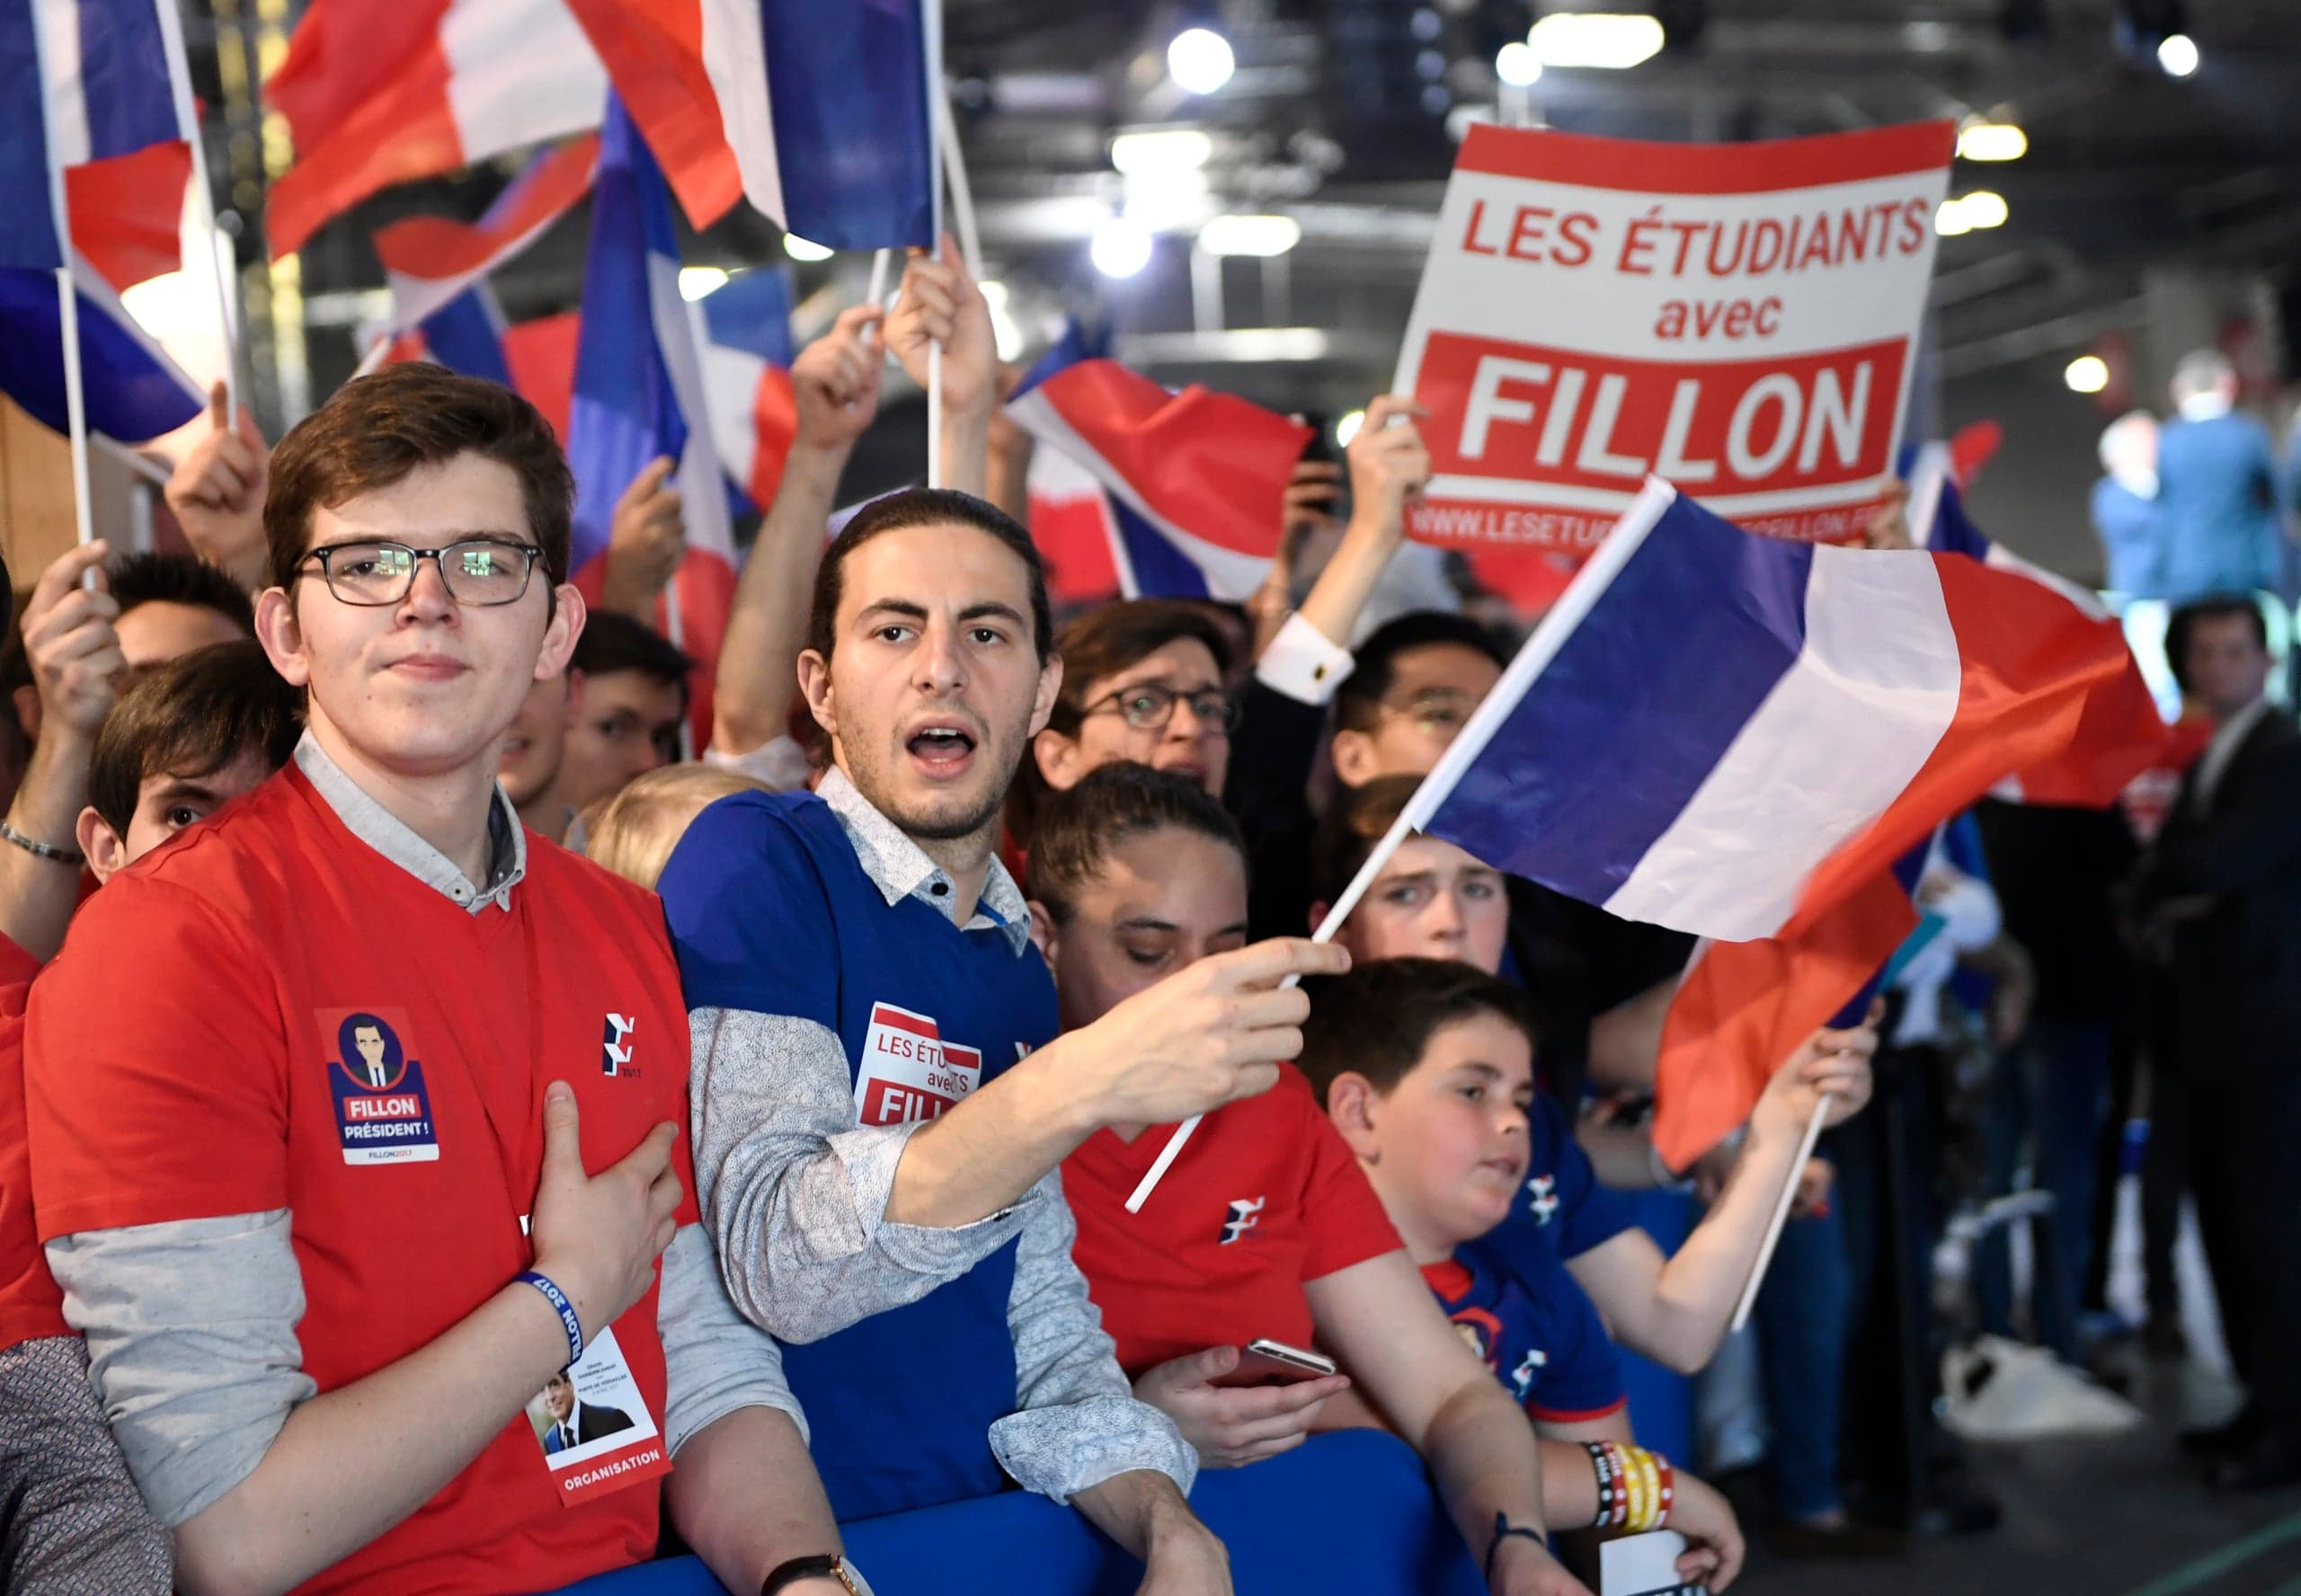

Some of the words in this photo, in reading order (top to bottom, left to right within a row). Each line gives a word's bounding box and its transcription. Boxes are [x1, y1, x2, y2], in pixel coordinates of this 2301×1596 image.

[1461, 198, 1599, 267] LES
[1615, 197, 1928, 278] ÉTUDIANTS
[1654, 295, 1782, 341] avec
[1457, 354, 1872, 483] FILLON
[877, 1033, 912, 1058] LES
[350, 1098, 415, 1118] FILLON
[344, 1122, 422, 1139] PRÉSIDENT
[532, 1278, 566, 1308] 2017
[564, 1449, 661, 1491] ORGANISATION
